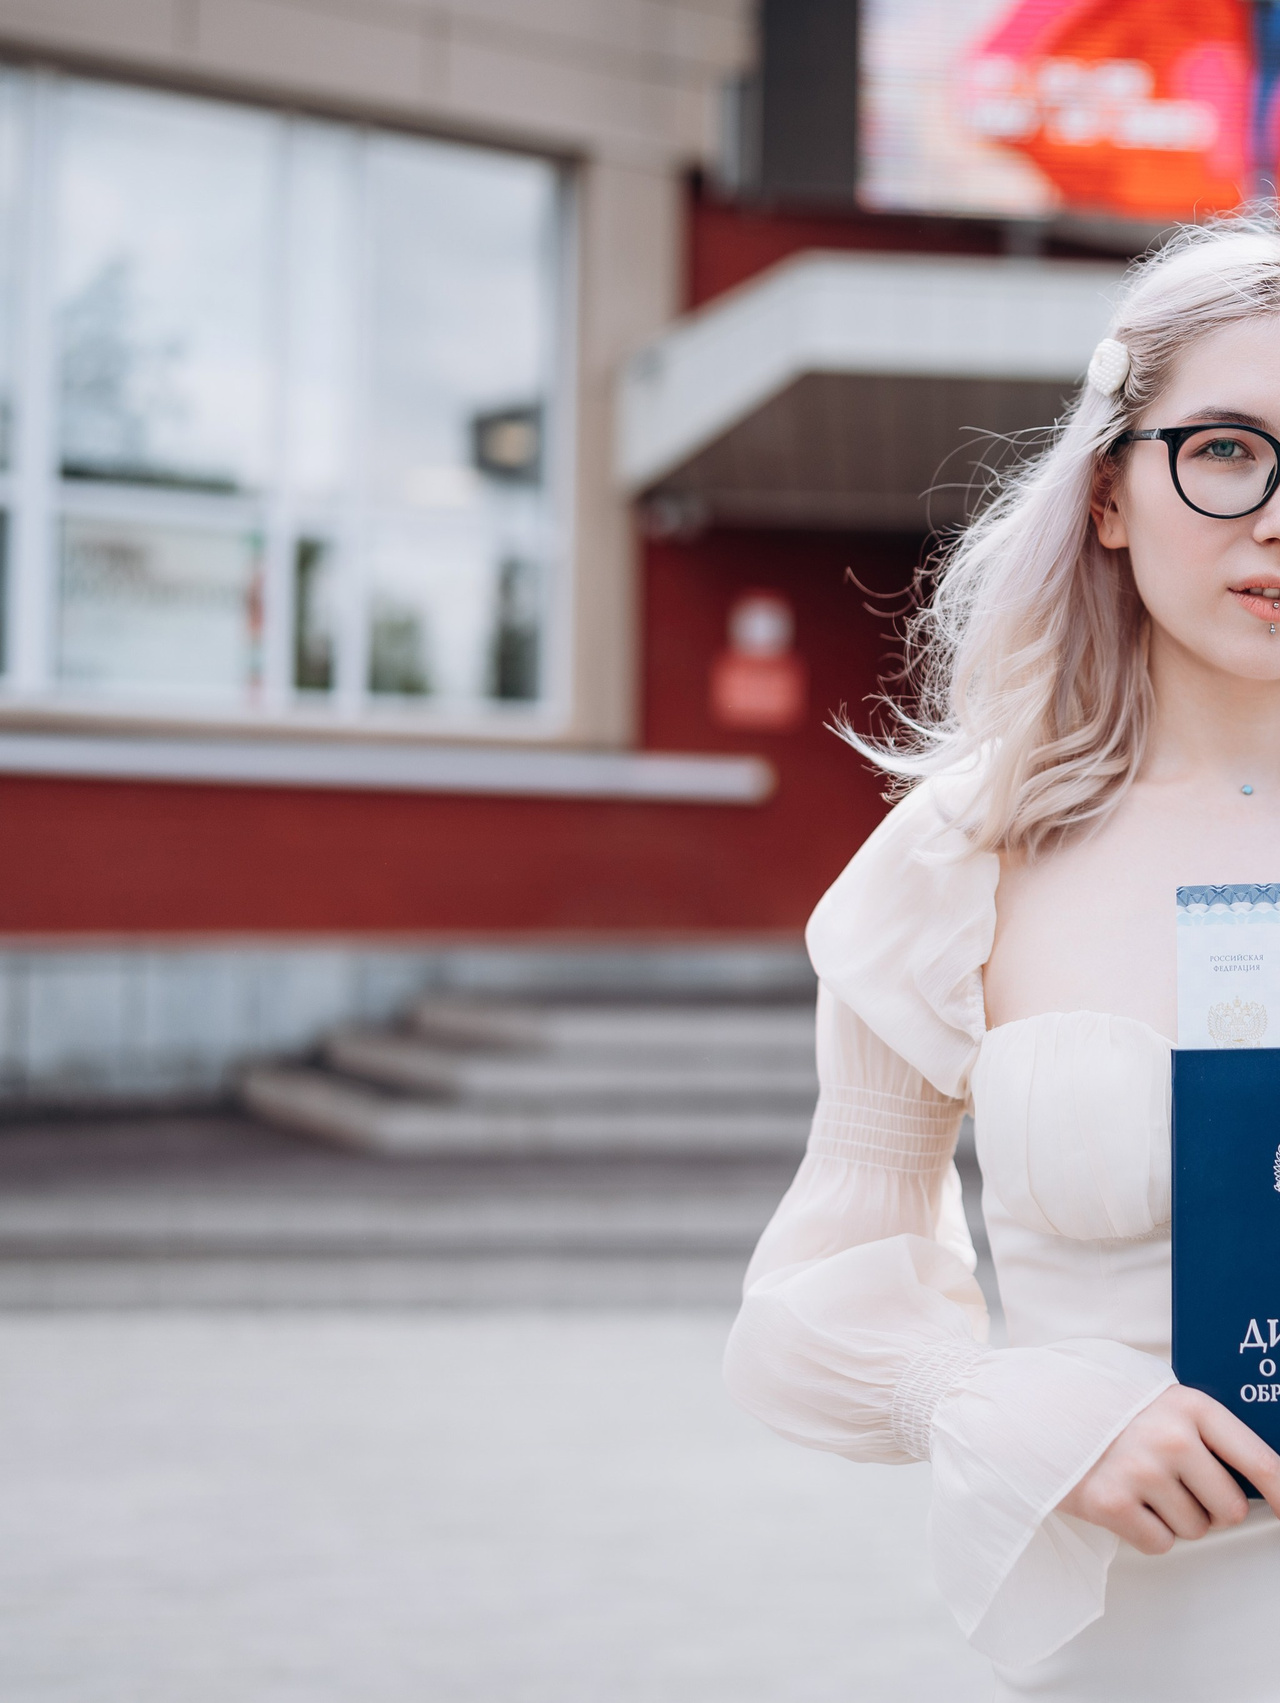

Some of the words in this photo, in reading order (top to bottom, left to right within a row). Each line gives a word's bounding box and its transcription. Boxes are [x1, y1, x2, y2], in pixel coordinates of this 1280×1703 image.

[1209, 953, 1264, 962] РОССИЙСКАЯ
[1213, 964, 1261, 973] ФЕДЕРАЦИЯ
[1259, 1358, 1276, 1377] О
